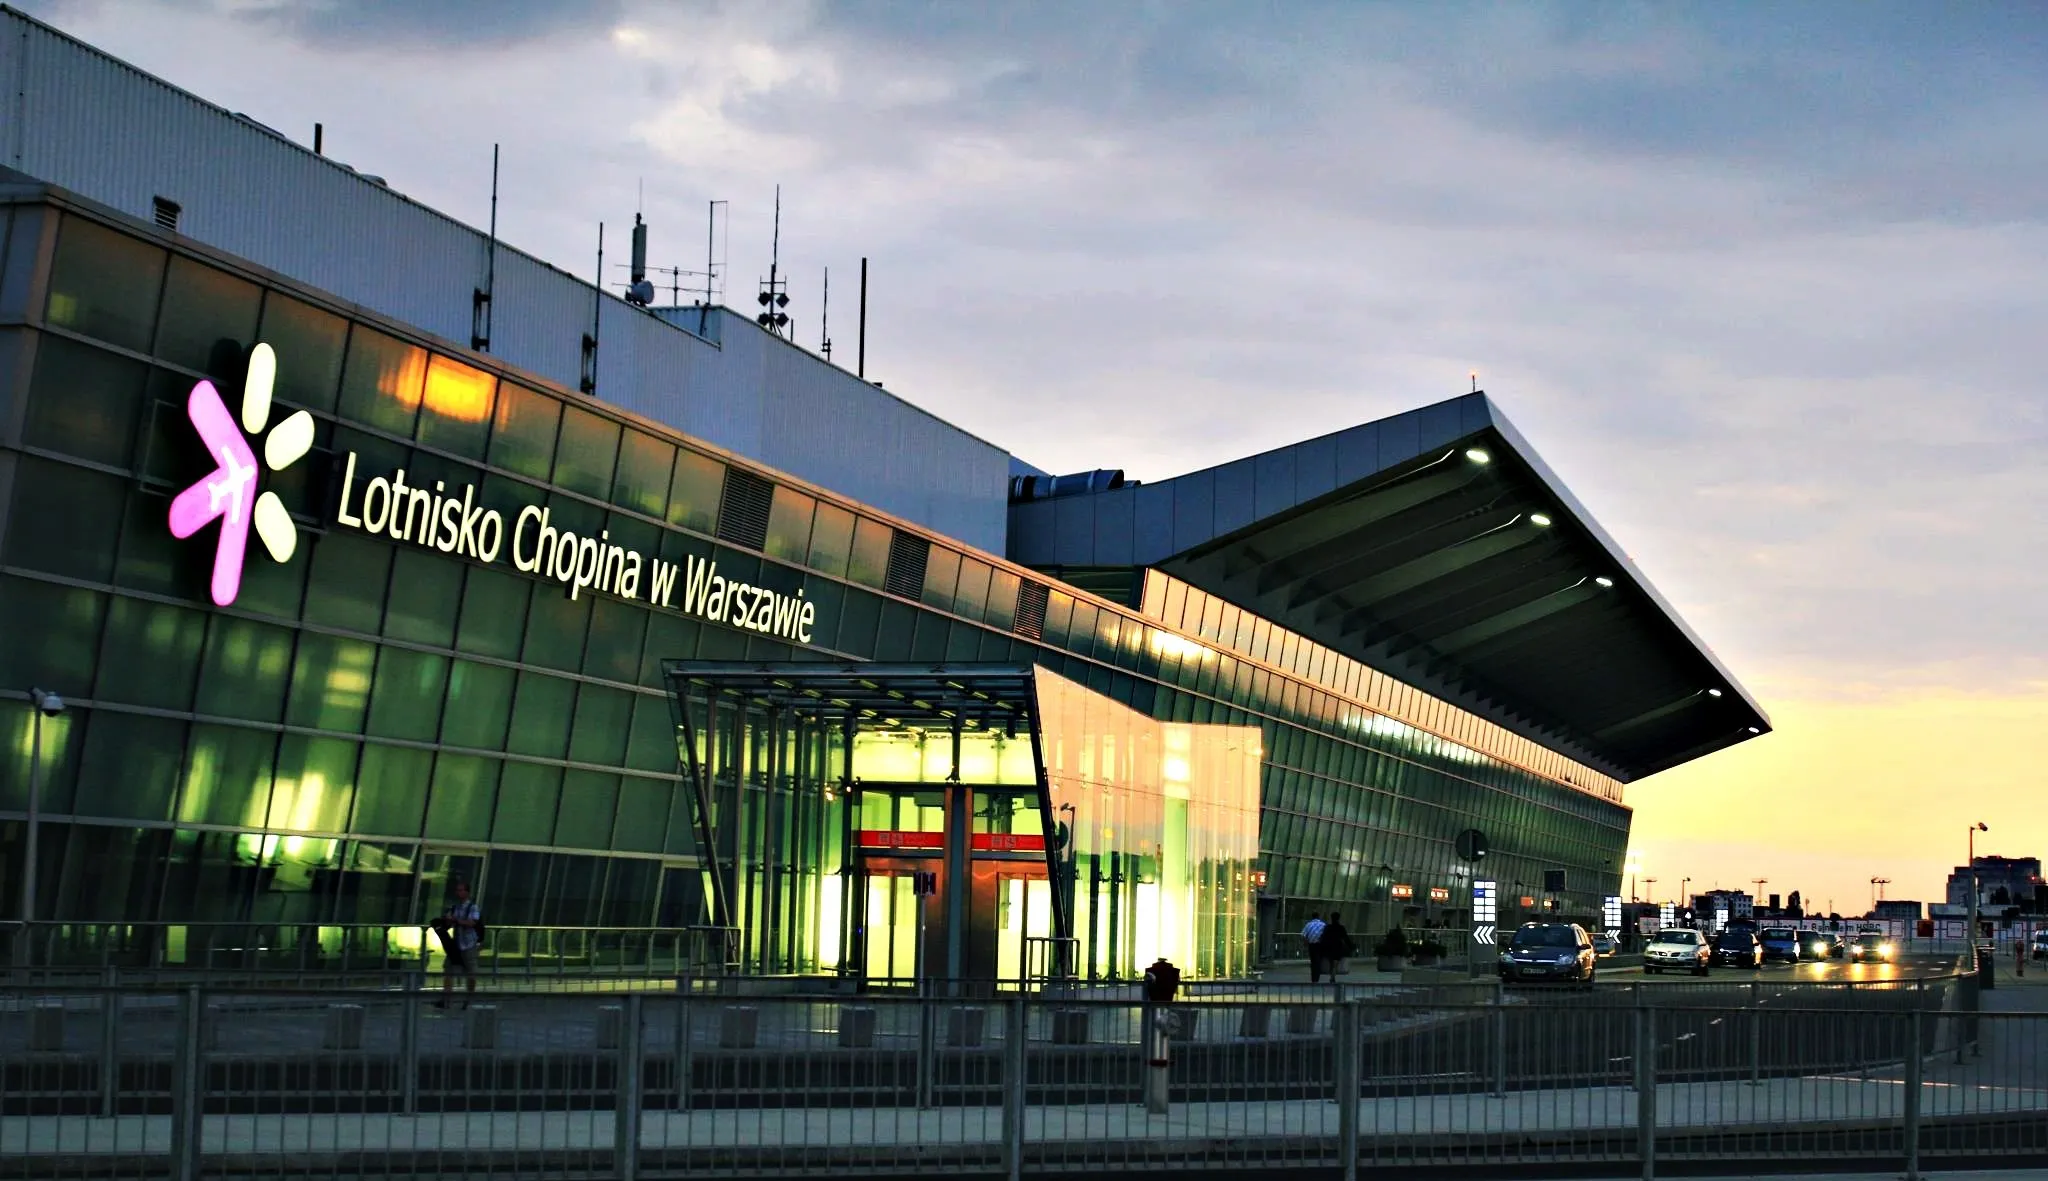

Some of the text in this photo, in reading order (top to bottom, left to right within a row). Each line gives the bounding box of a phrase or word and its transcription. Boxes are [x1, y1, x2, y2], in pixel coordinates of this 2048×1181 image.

[337, 451, 815, 645] Lotnisko Chopina w Warszawie
